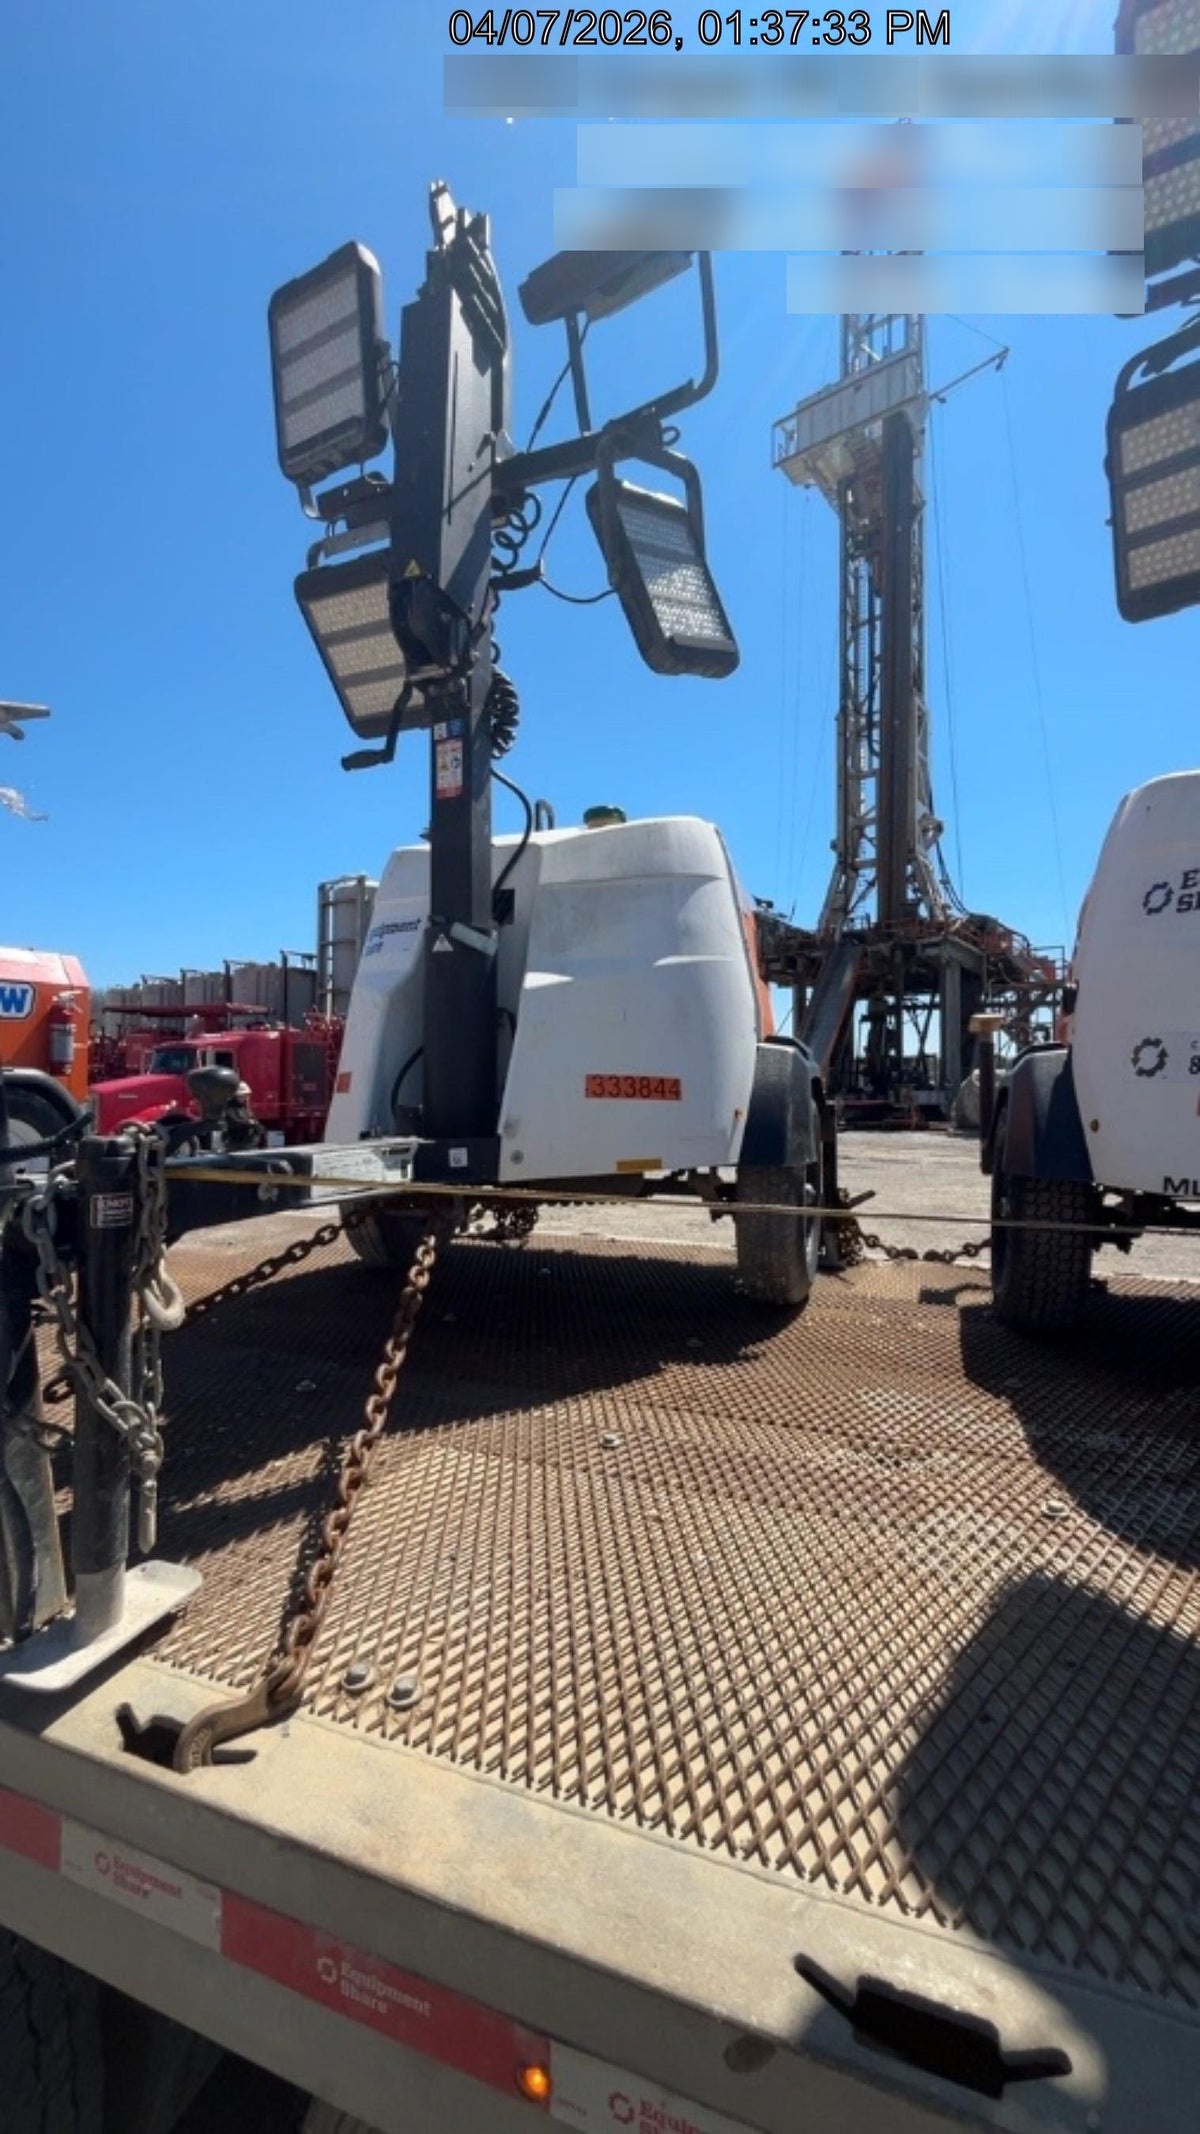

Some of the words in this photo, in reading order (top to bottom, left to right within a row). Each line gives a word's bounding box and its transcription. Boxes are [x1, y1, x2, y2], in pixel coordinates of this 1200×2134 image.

[591, 1075, 680, 1099] 333844
[341, 1960, 431, 2018] Equipment
[341, 1978, 388, 2014] Share
